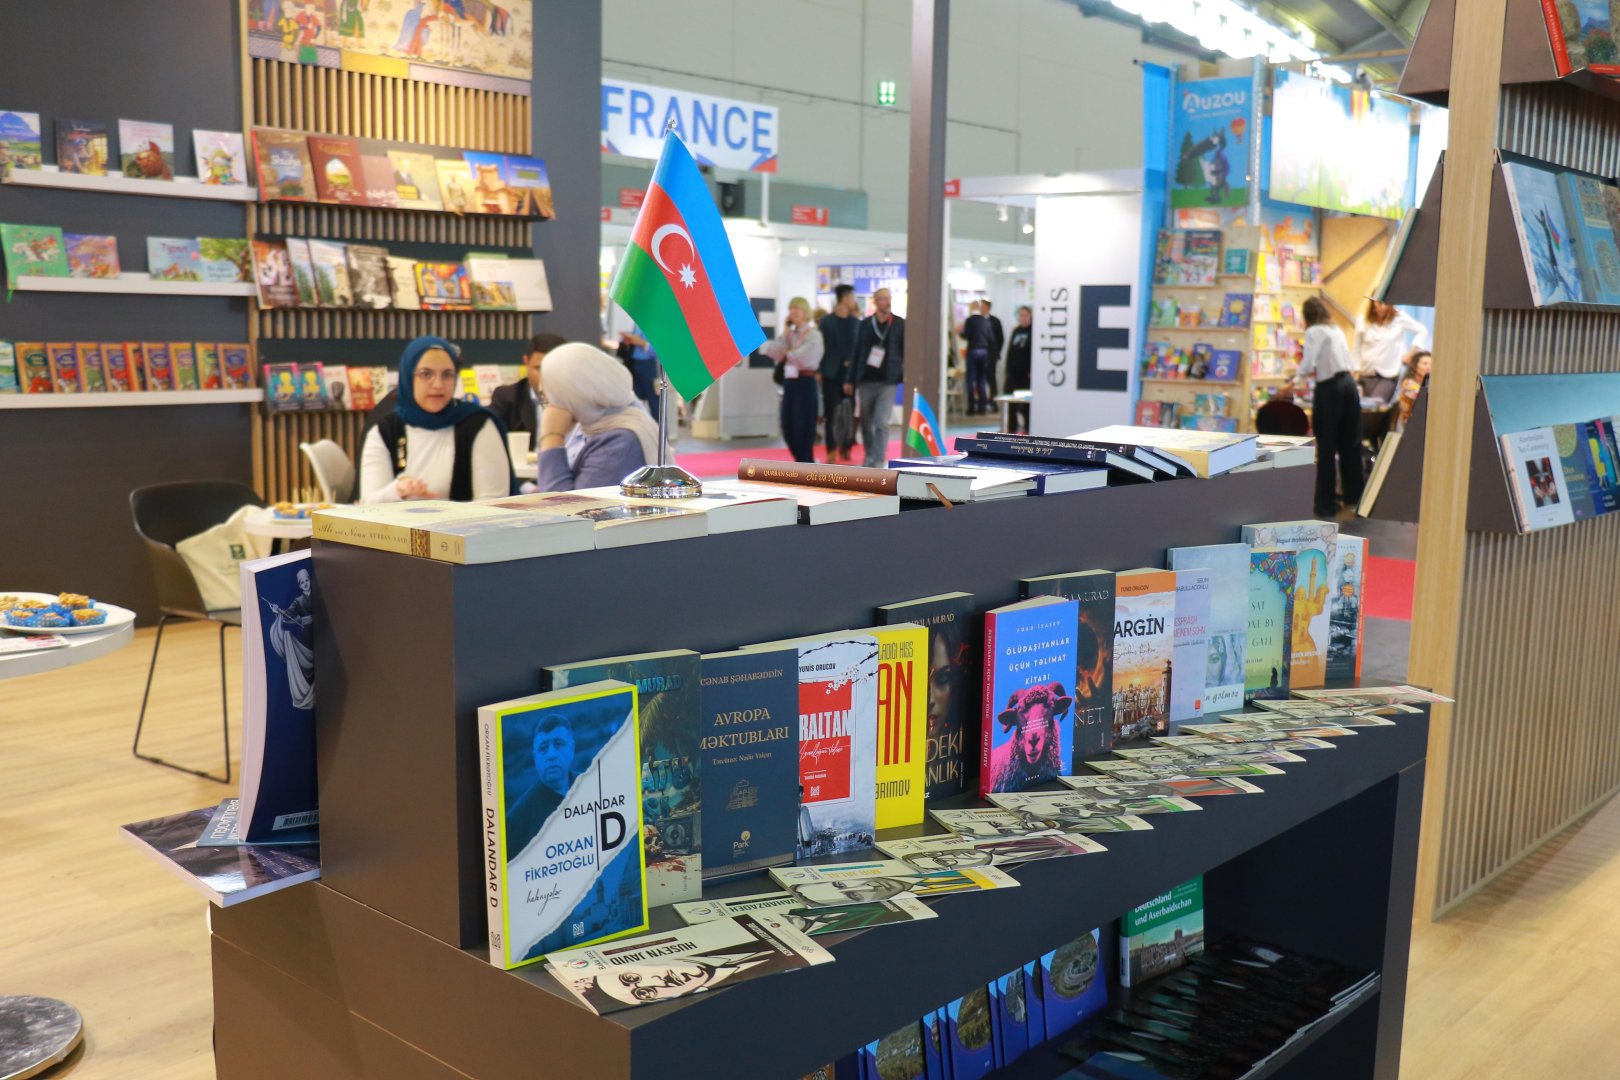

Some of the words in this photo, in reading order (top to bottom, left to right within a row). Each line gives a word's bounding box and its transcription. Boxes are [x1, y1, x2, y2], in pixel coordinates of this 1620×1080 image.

[601, 84, 773, 154] FRANCE
[1041, 286, 1069, 388] editis
[1076, 285, 1131, 392] E
[1008, 661, 1031, 673] ÜÇÜN
[700, 675, 729, 687] CƏNAB
[713, 707, 772, 726] AVROPA
[564, 794, 626, 820] DALANDAR
[600, 811, 627, 852] D
[486, 807, 498, 892] DALANDAR
[545, 835, 594, 859] ORXAN
[525, 853, 595, 882] FİKRƏTOĞLU
[490, 897, 499, 909] D
[1134, 913, 1148, 926] und
[1148, 898, 1192, 921] Aserbaidschan
[610, 949, 646, 966] JAVID
[648, 940, 698, 960] HUSEYN
